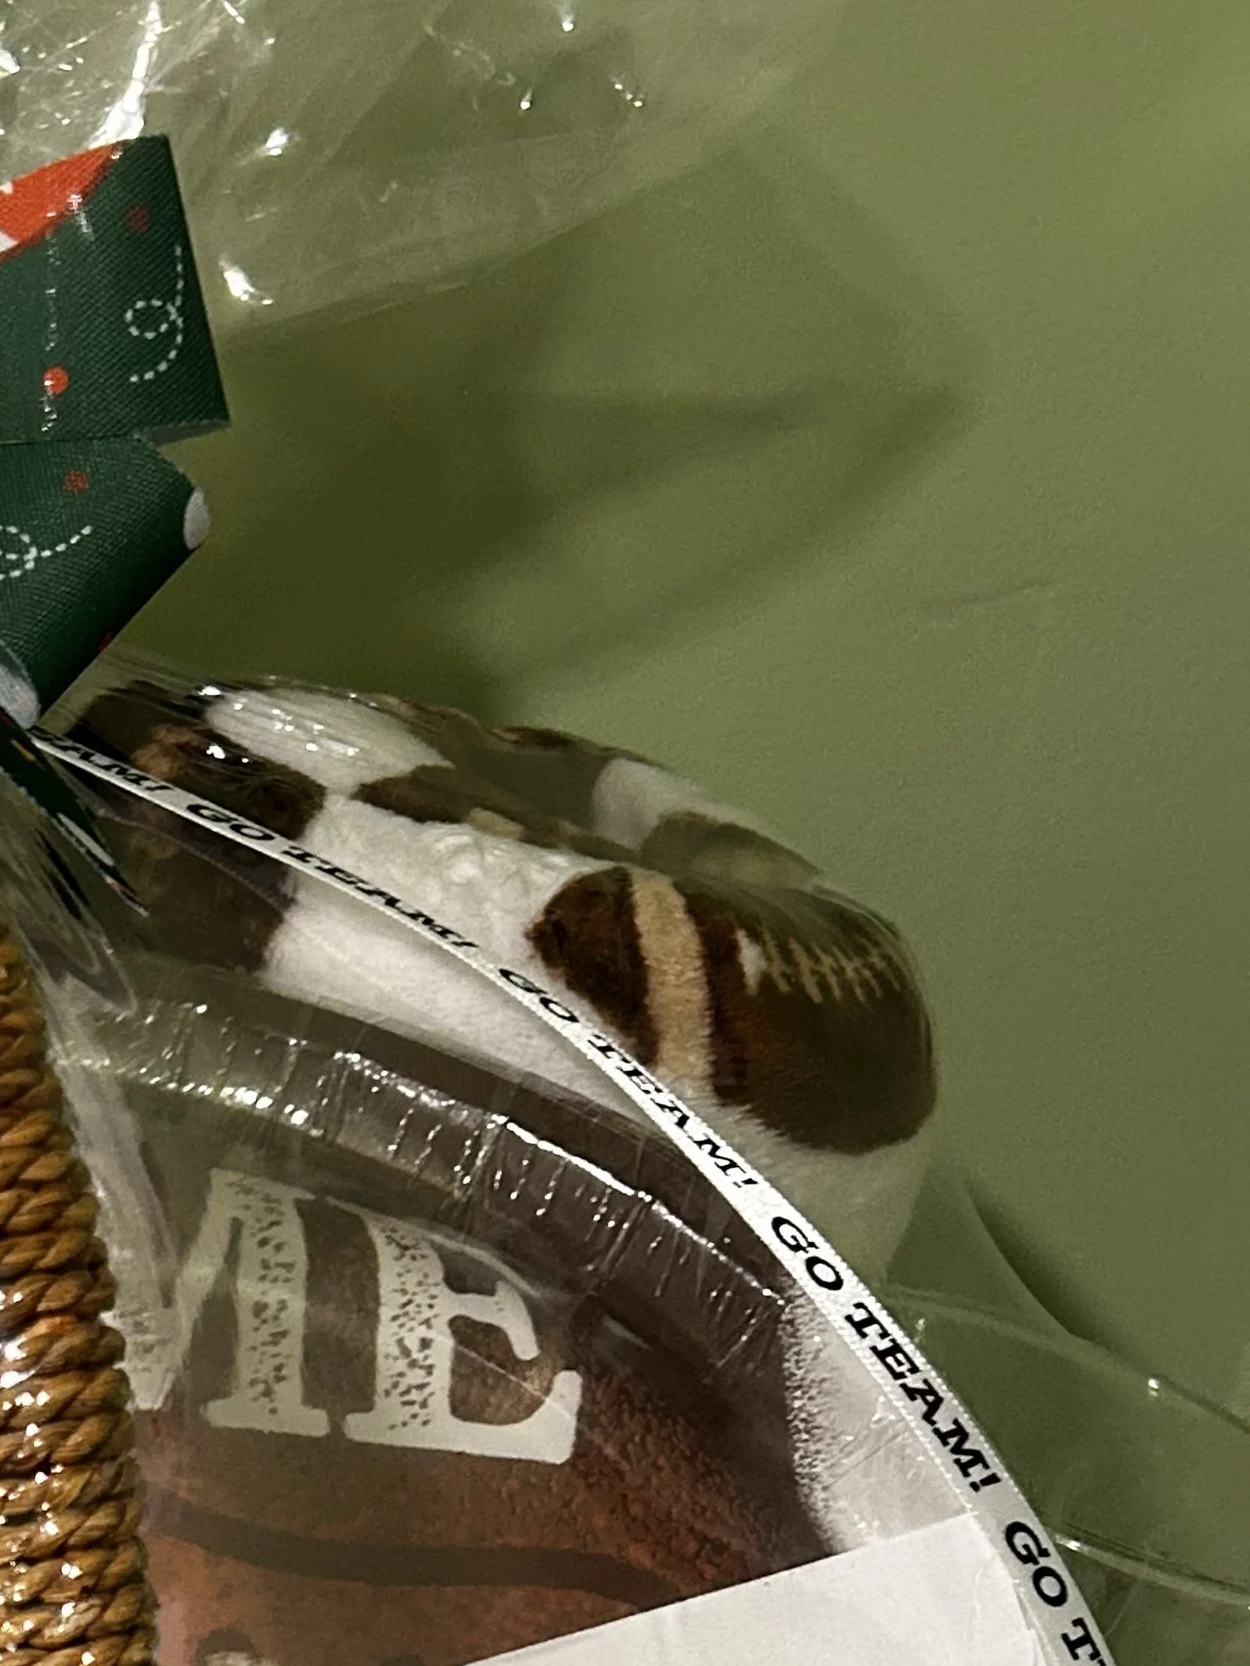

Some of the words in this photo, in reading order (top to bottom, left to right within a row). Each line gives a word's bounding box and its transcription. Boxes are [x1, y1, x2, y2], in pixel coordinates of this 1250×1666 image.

[186, 803, 276, 842] GO
[282, 845, 480, 948] TEAM!
[500, 968, 579, 1023] GO
[585, 1030, 759, 1190] TEAM!
[771, 1215, 844, 1292] GO
[844, 1301, 1003, 1493] TEAM!
[1004, 1520, 1069, 1609] GO
